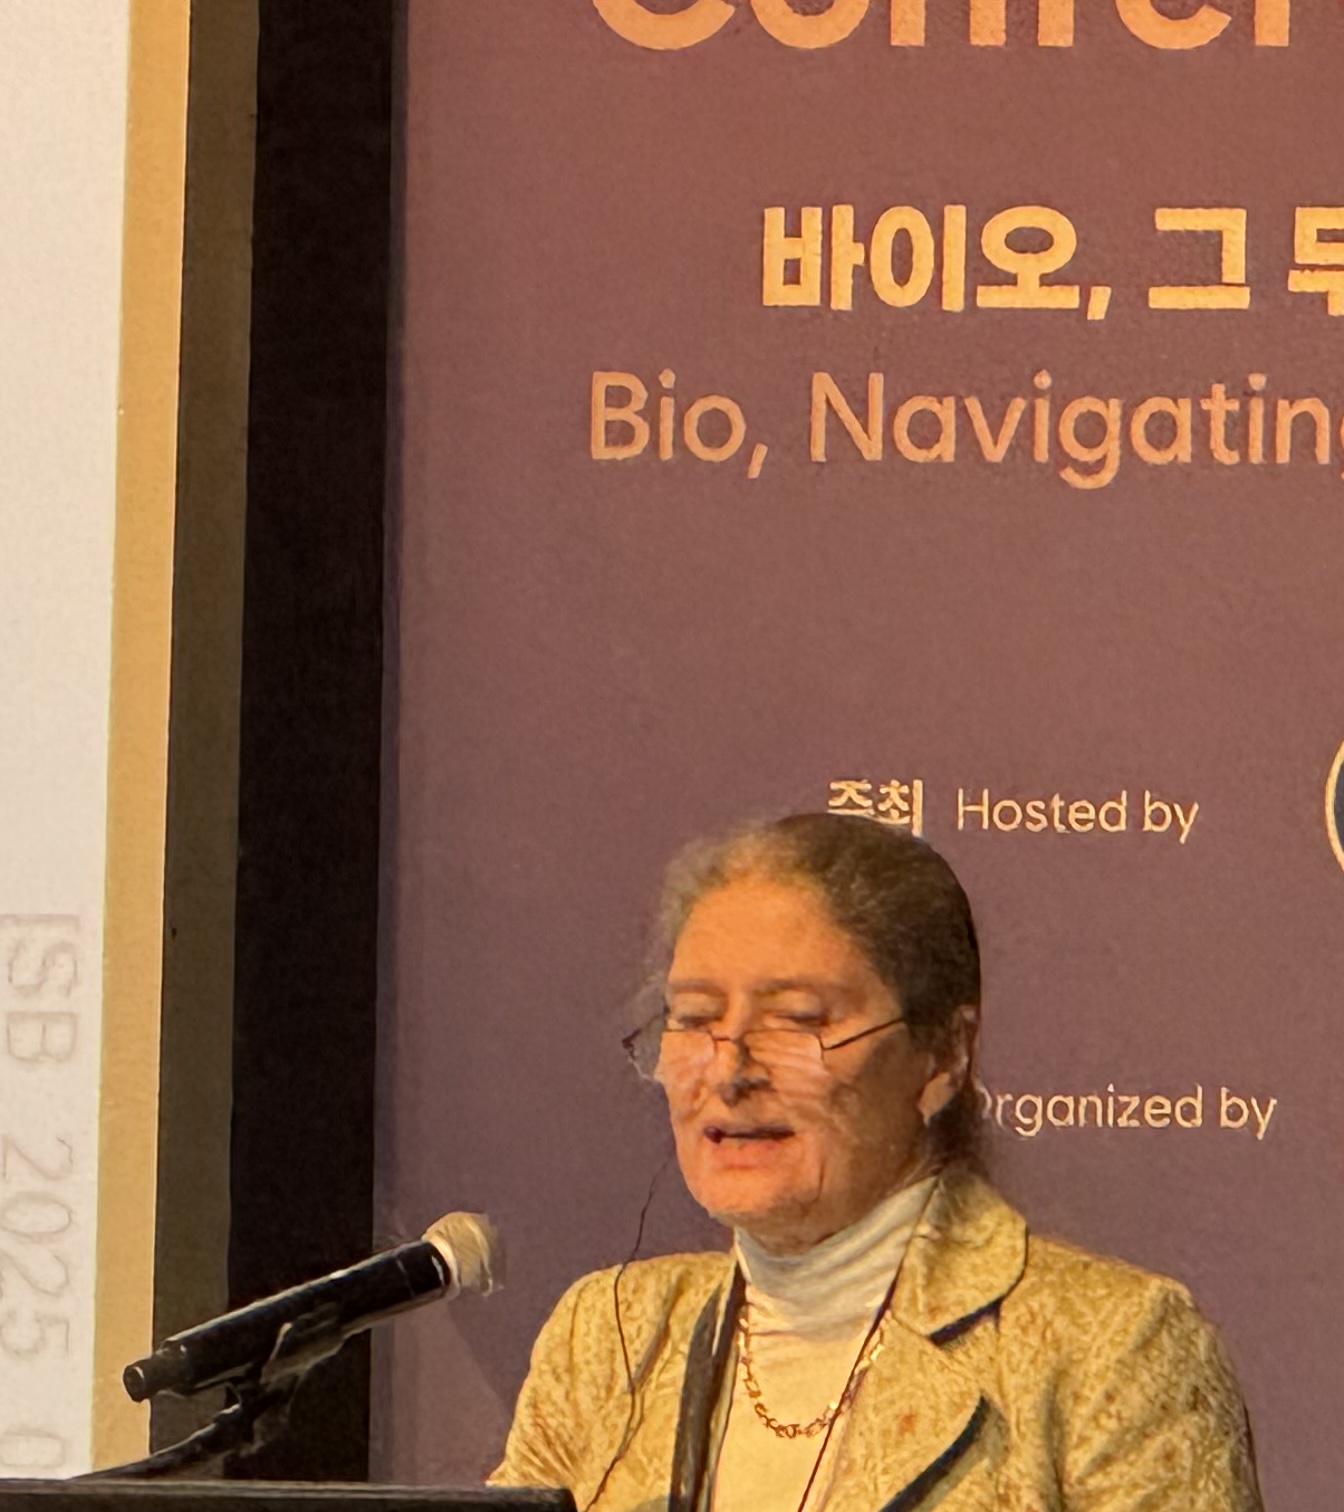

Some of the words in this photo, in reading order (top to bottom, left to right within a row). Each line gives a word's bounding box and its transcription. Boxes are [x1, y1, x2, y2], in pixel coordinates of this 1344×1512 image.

[762, 204, 1112, 321] 바이오,
[1148, 207, 1251, 310] 그
[591, 368, 768, 479] Bio,
[957, 788, 1128, 833] Hosted
[1143, 790, 1199, 844] by
[978, 1084, 1204, 1137] rganized
[1220, 1086, 1278, 1140] by
